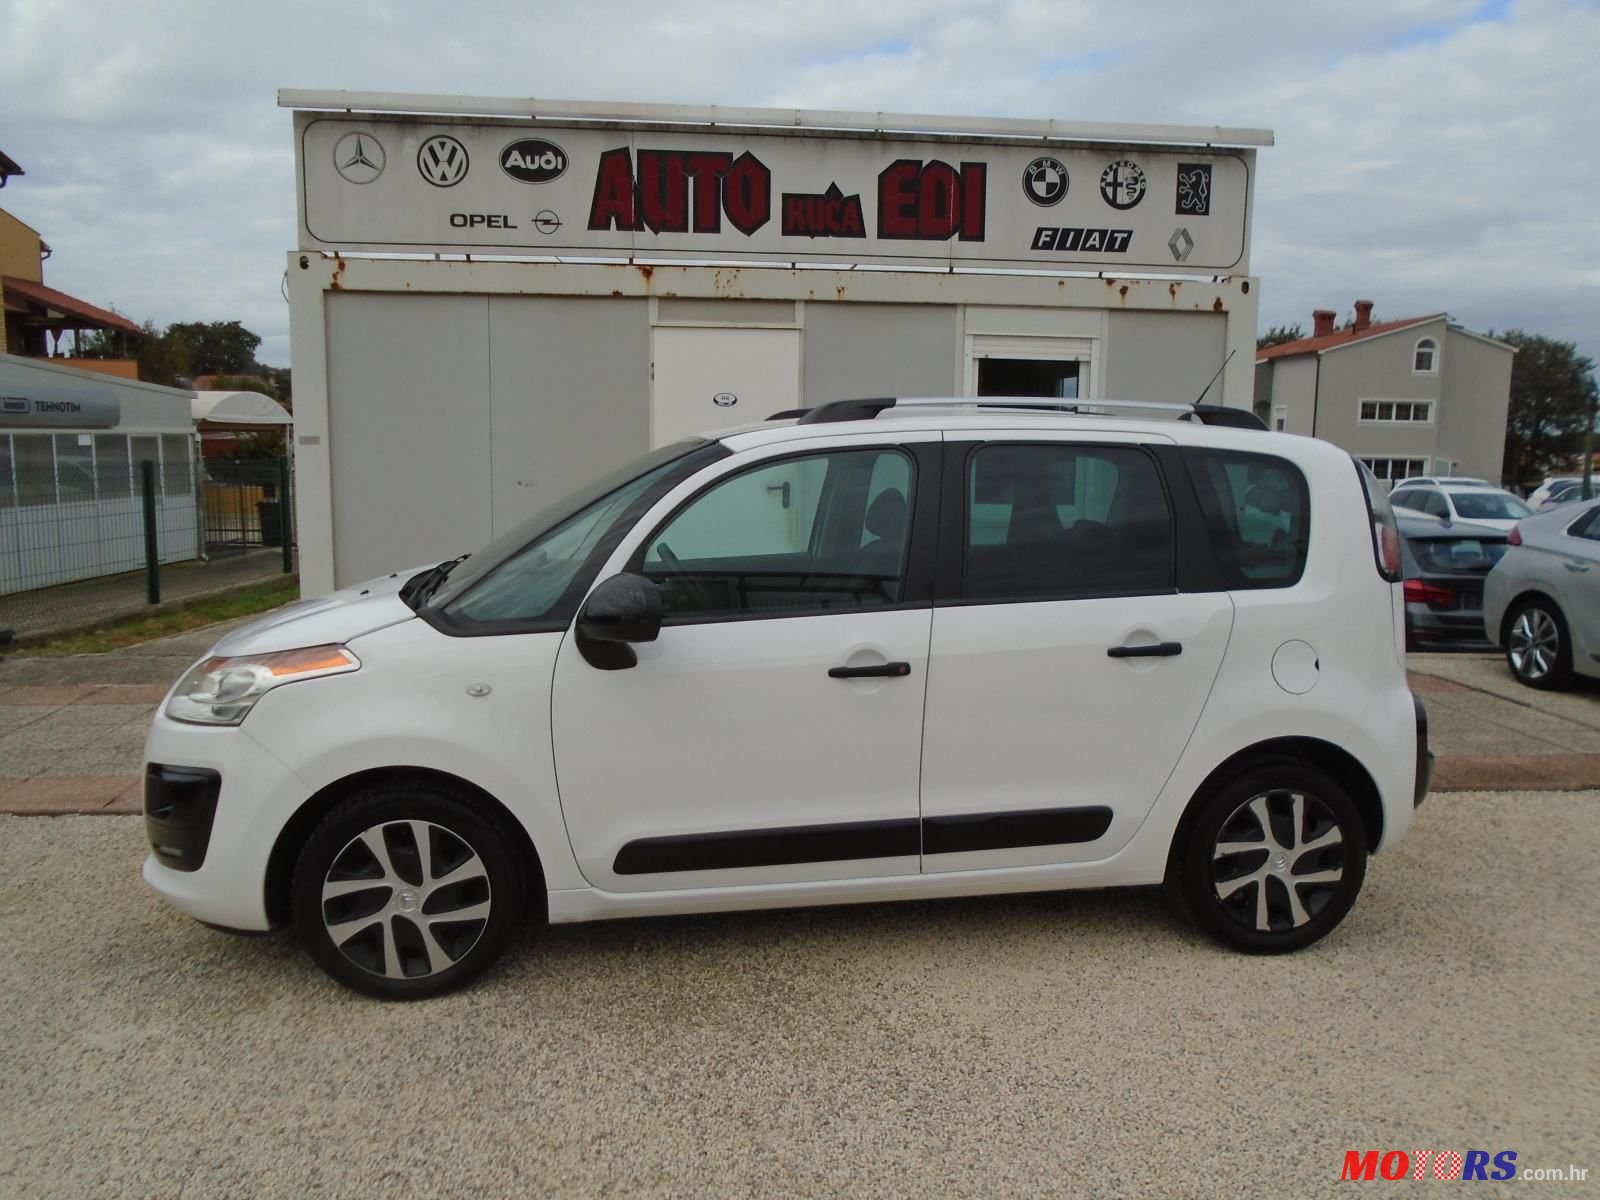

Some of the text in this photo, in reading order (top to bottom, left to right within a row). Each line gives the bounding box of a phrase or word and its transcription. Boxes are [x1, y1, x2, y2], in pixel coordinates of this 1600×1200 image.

[504, 150, 563, 170] Audi
[587, 146, 771, 237] AUTO
[876, 159, 987, 242] EDI
[449, 213, 518, 229] OPEL
[1035, 229, 1131, 250] FIAT
